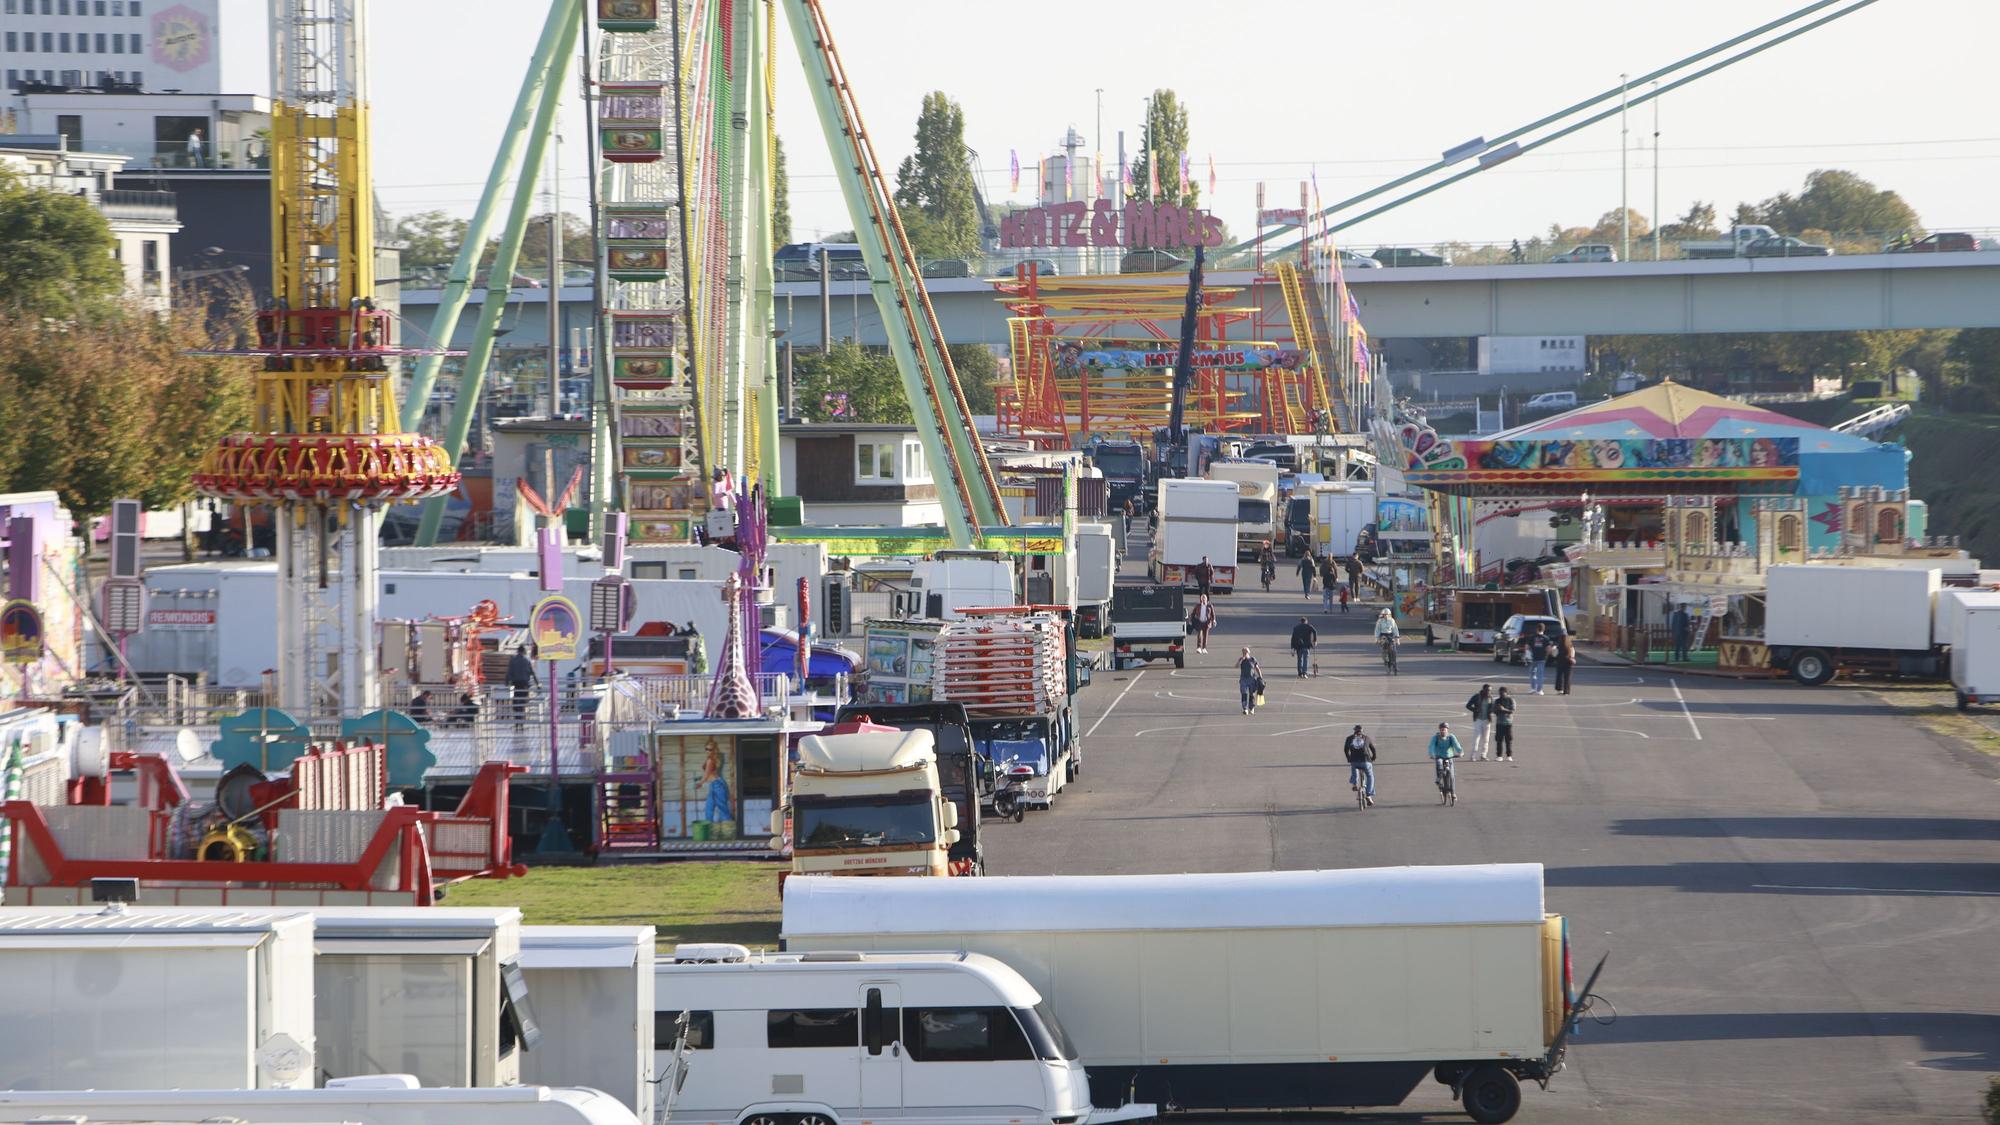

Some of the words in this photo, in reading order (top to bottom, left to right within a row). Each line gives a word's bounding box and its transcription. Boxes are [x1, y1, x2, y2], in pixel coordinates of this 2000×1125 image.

[1001, 201, 1087, 248] KATZ
[1091, 199, 1119, 247] &
[1124, 200, 1223, 247] MAUS
[1200, 351, 1245, 366] MAUS
